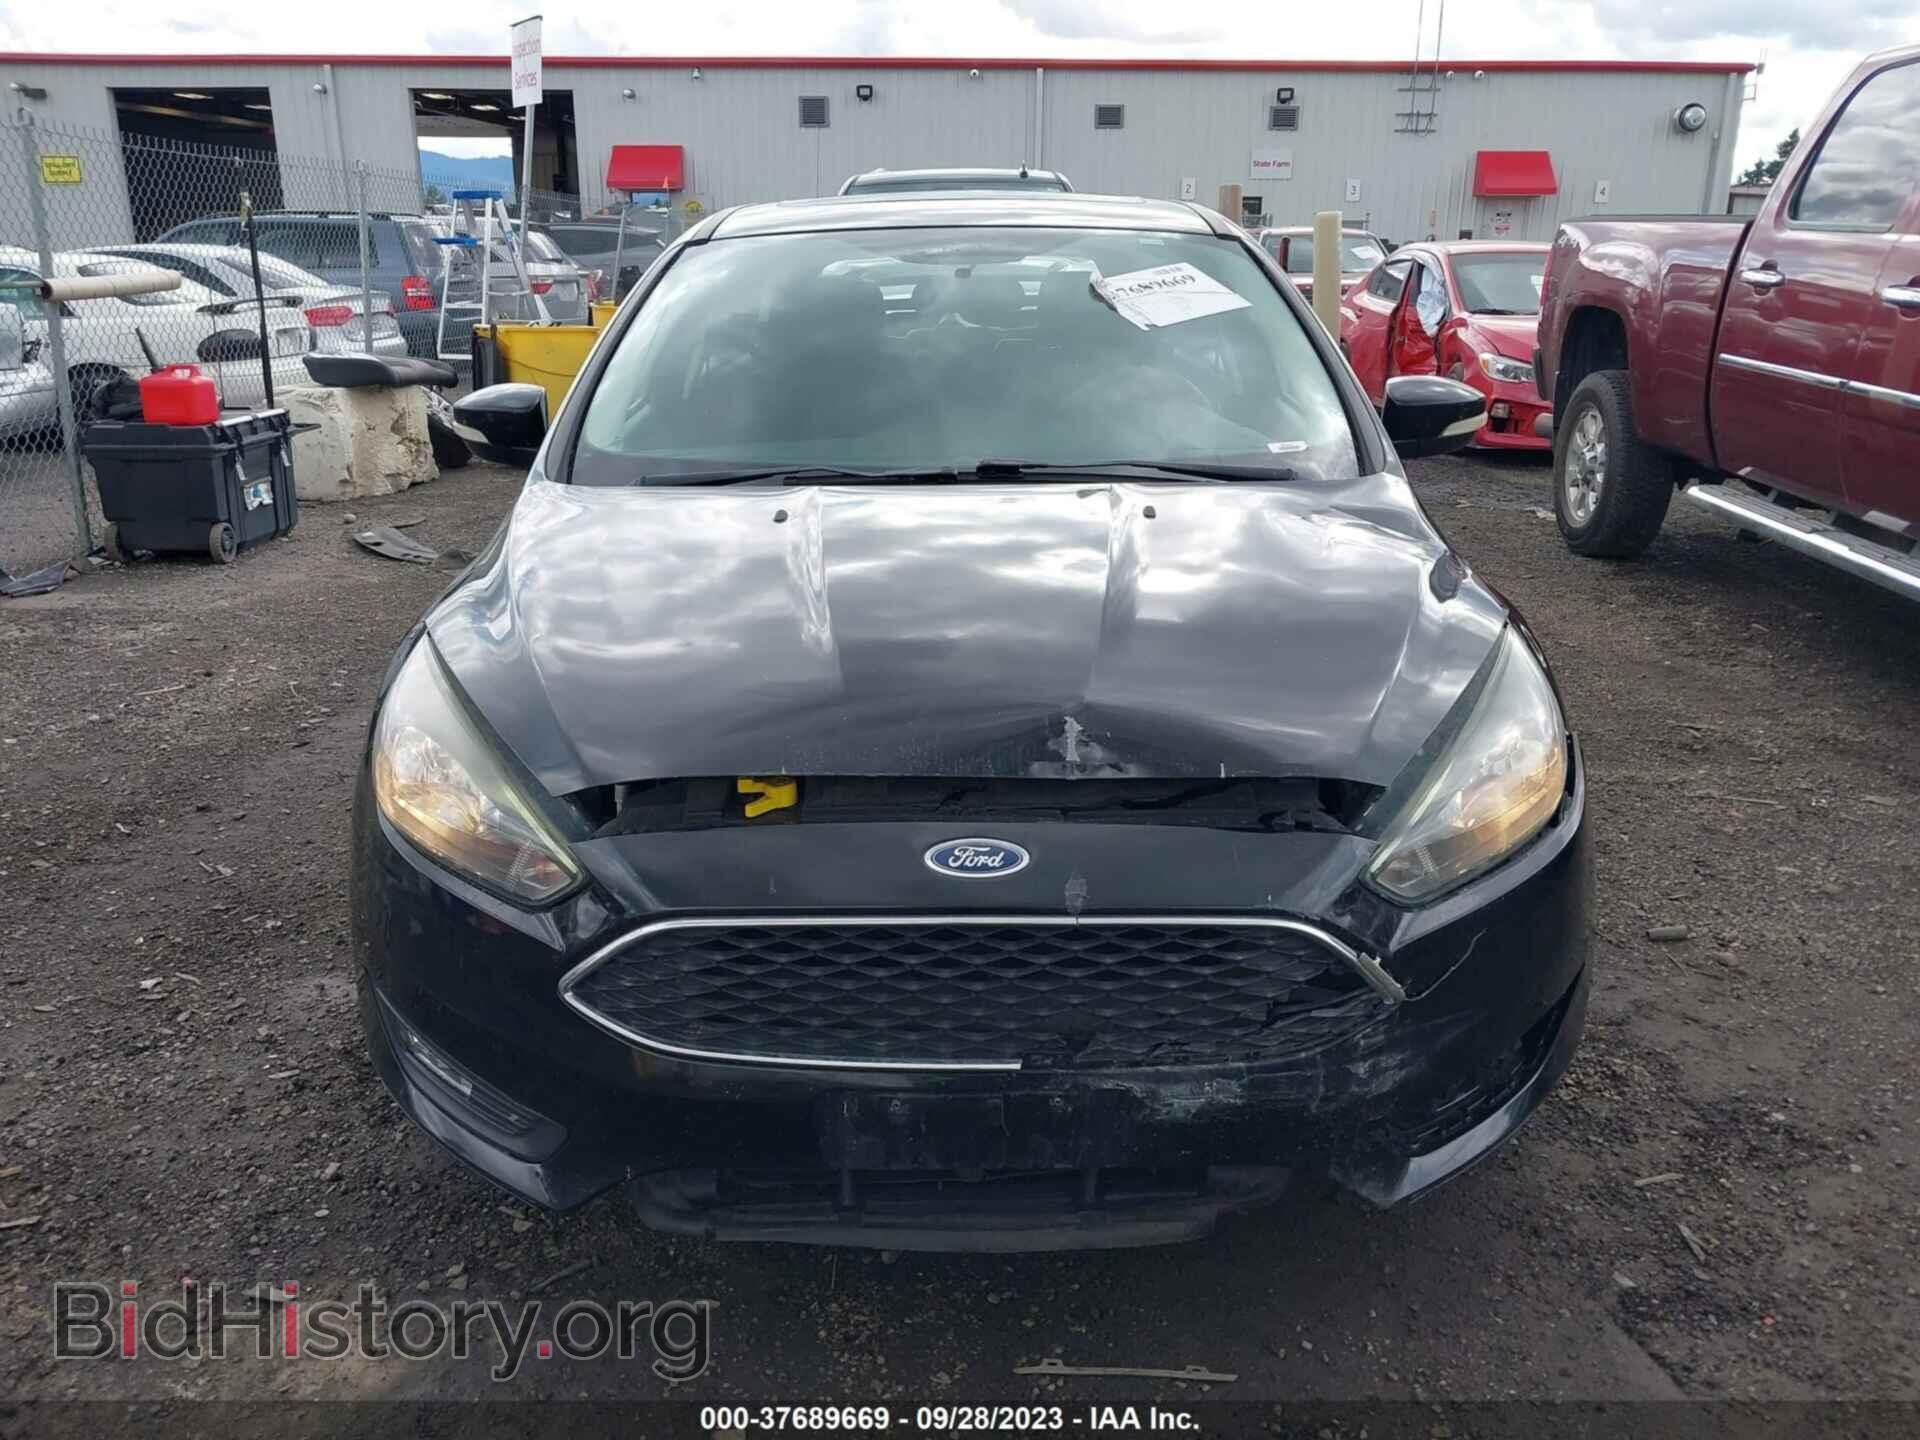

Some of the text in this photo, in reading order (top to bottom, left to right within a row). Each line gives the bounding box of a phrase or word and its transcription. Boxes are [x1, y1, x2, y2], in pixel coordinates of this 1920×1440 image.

[1252, 159, 1291, 168] State Farm
[1184, 183, 1192, 194] 2
[1350, 184, 1357, 196] 3
[1599, 185, 1606, 196] 4
[948, 846, 1005, 868] Ford
